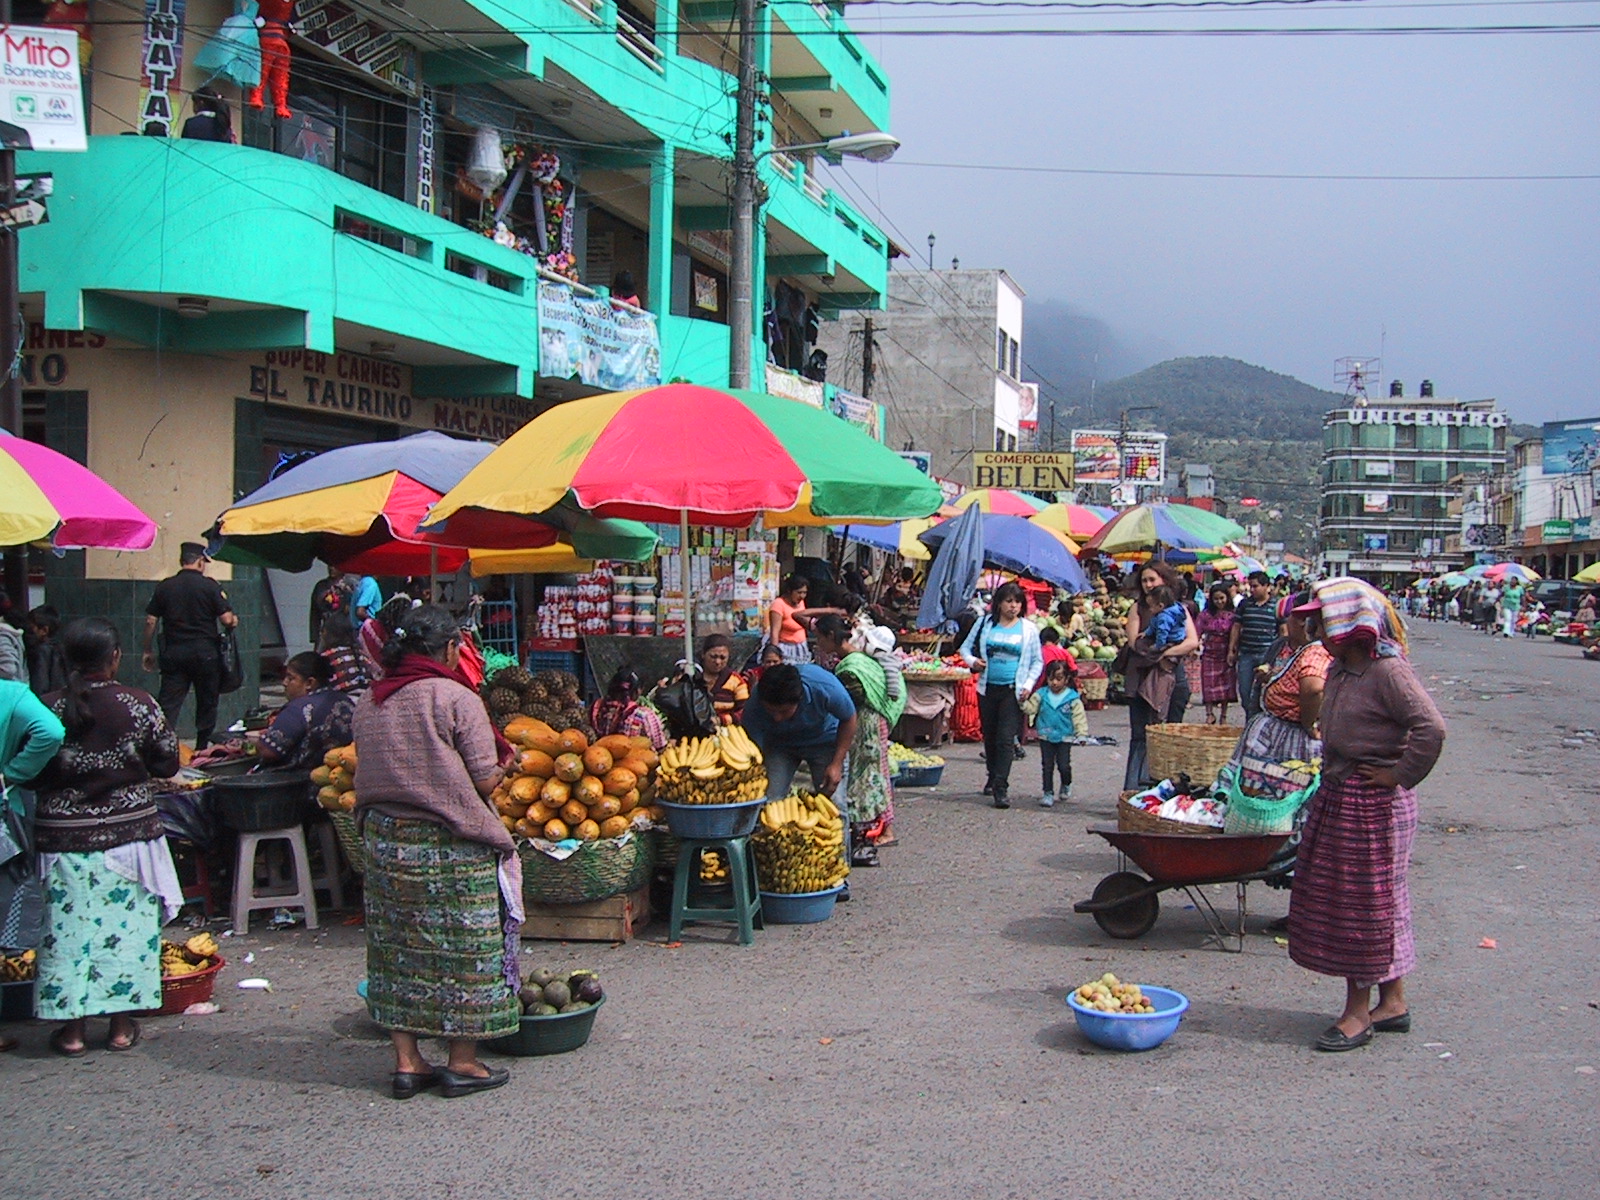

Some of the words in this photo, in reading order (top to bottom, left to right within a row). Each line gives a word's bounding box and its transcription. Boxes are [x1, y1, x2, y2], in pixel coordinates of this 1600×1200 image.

[5, 33, 71, 68] Mito
[20, 354, 69, 385] NO
[265, 350, 327, 374] SUPER
[337, 356, 401, 389] CARNES
[250, 364, 288, 400] EL
[303, 376, 413, 421] TAURINO
[434, 403, 521, 439] MACARE
[1346, 409, 1508, 430] UNICENTRO
[984, 453, 1043, 465] COMERCIAL
[976, 465, 1072, 489] BELEN
